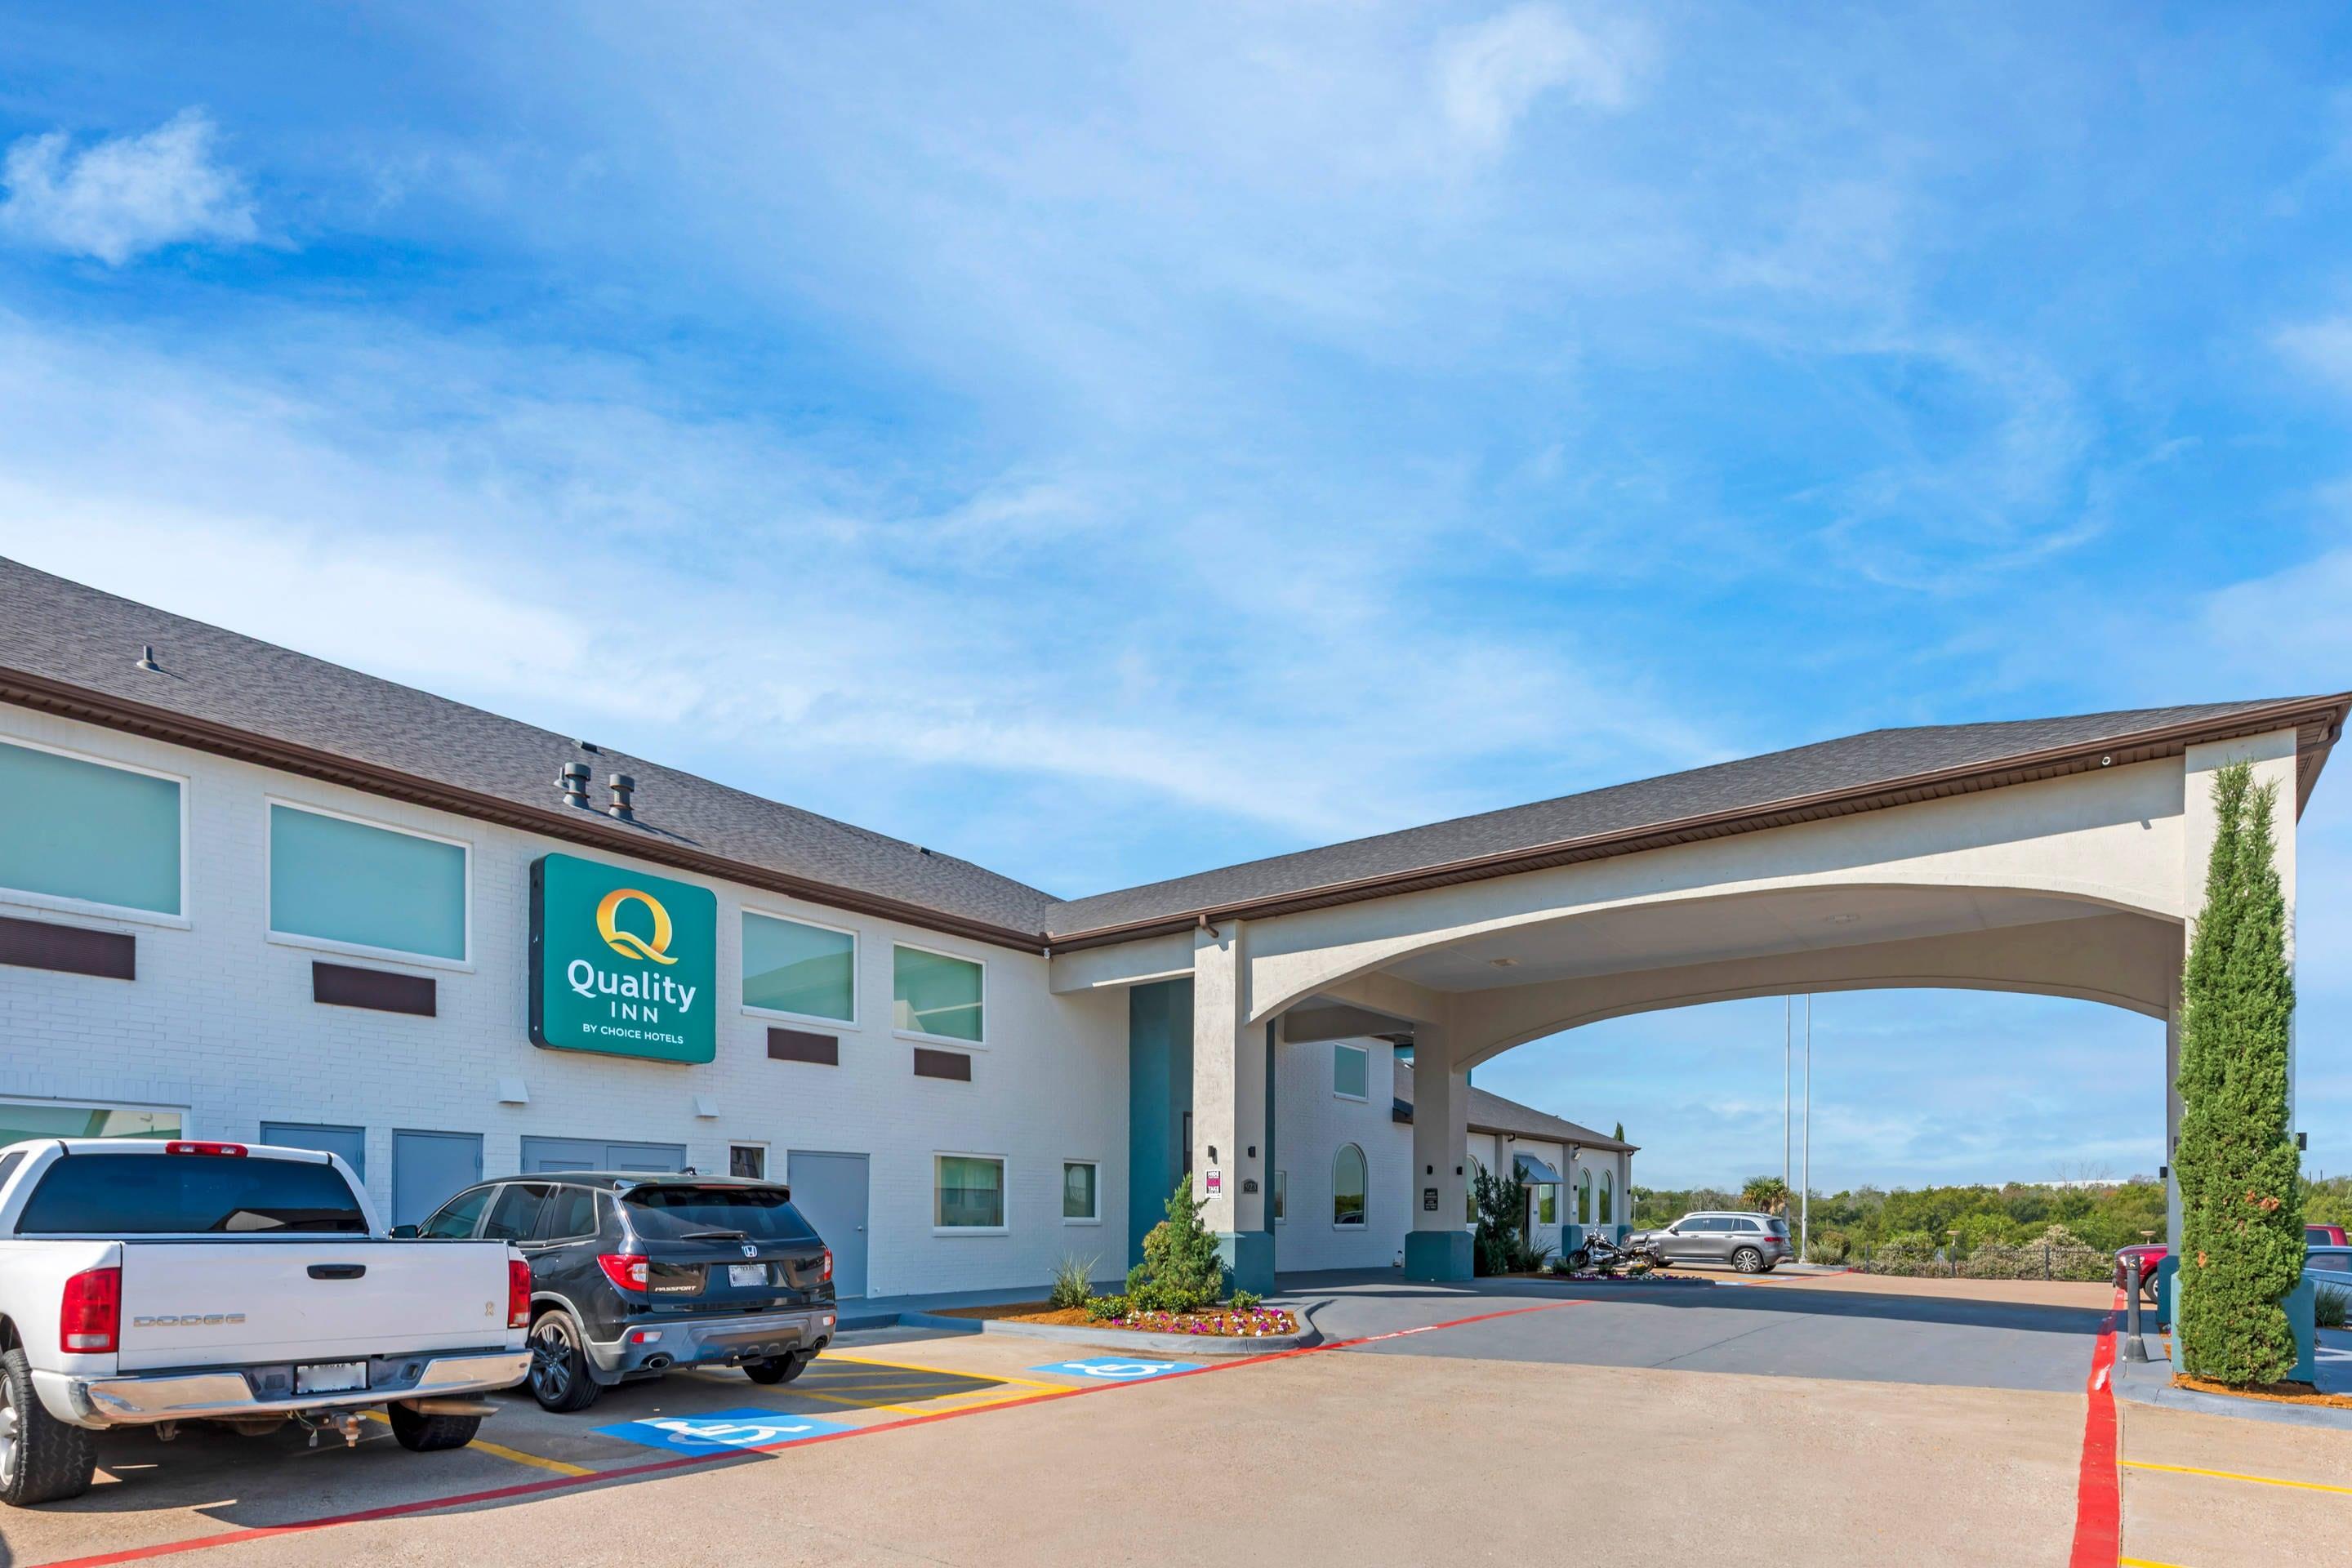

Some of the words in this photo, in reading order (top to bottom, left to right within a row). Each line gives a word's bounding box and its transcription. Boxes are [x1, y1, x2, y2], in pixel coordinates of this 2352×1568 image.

[568, 960, 697, 1013] Quality
[611, 1001, 658, 1023] INN
[582, 1023, 597, 1033] BY
[600, 1026, 641, 1039] CHOICE
[644, 1031, 684, 1045] HOTELS
[133, 1313, 247, 1327] DODGE
